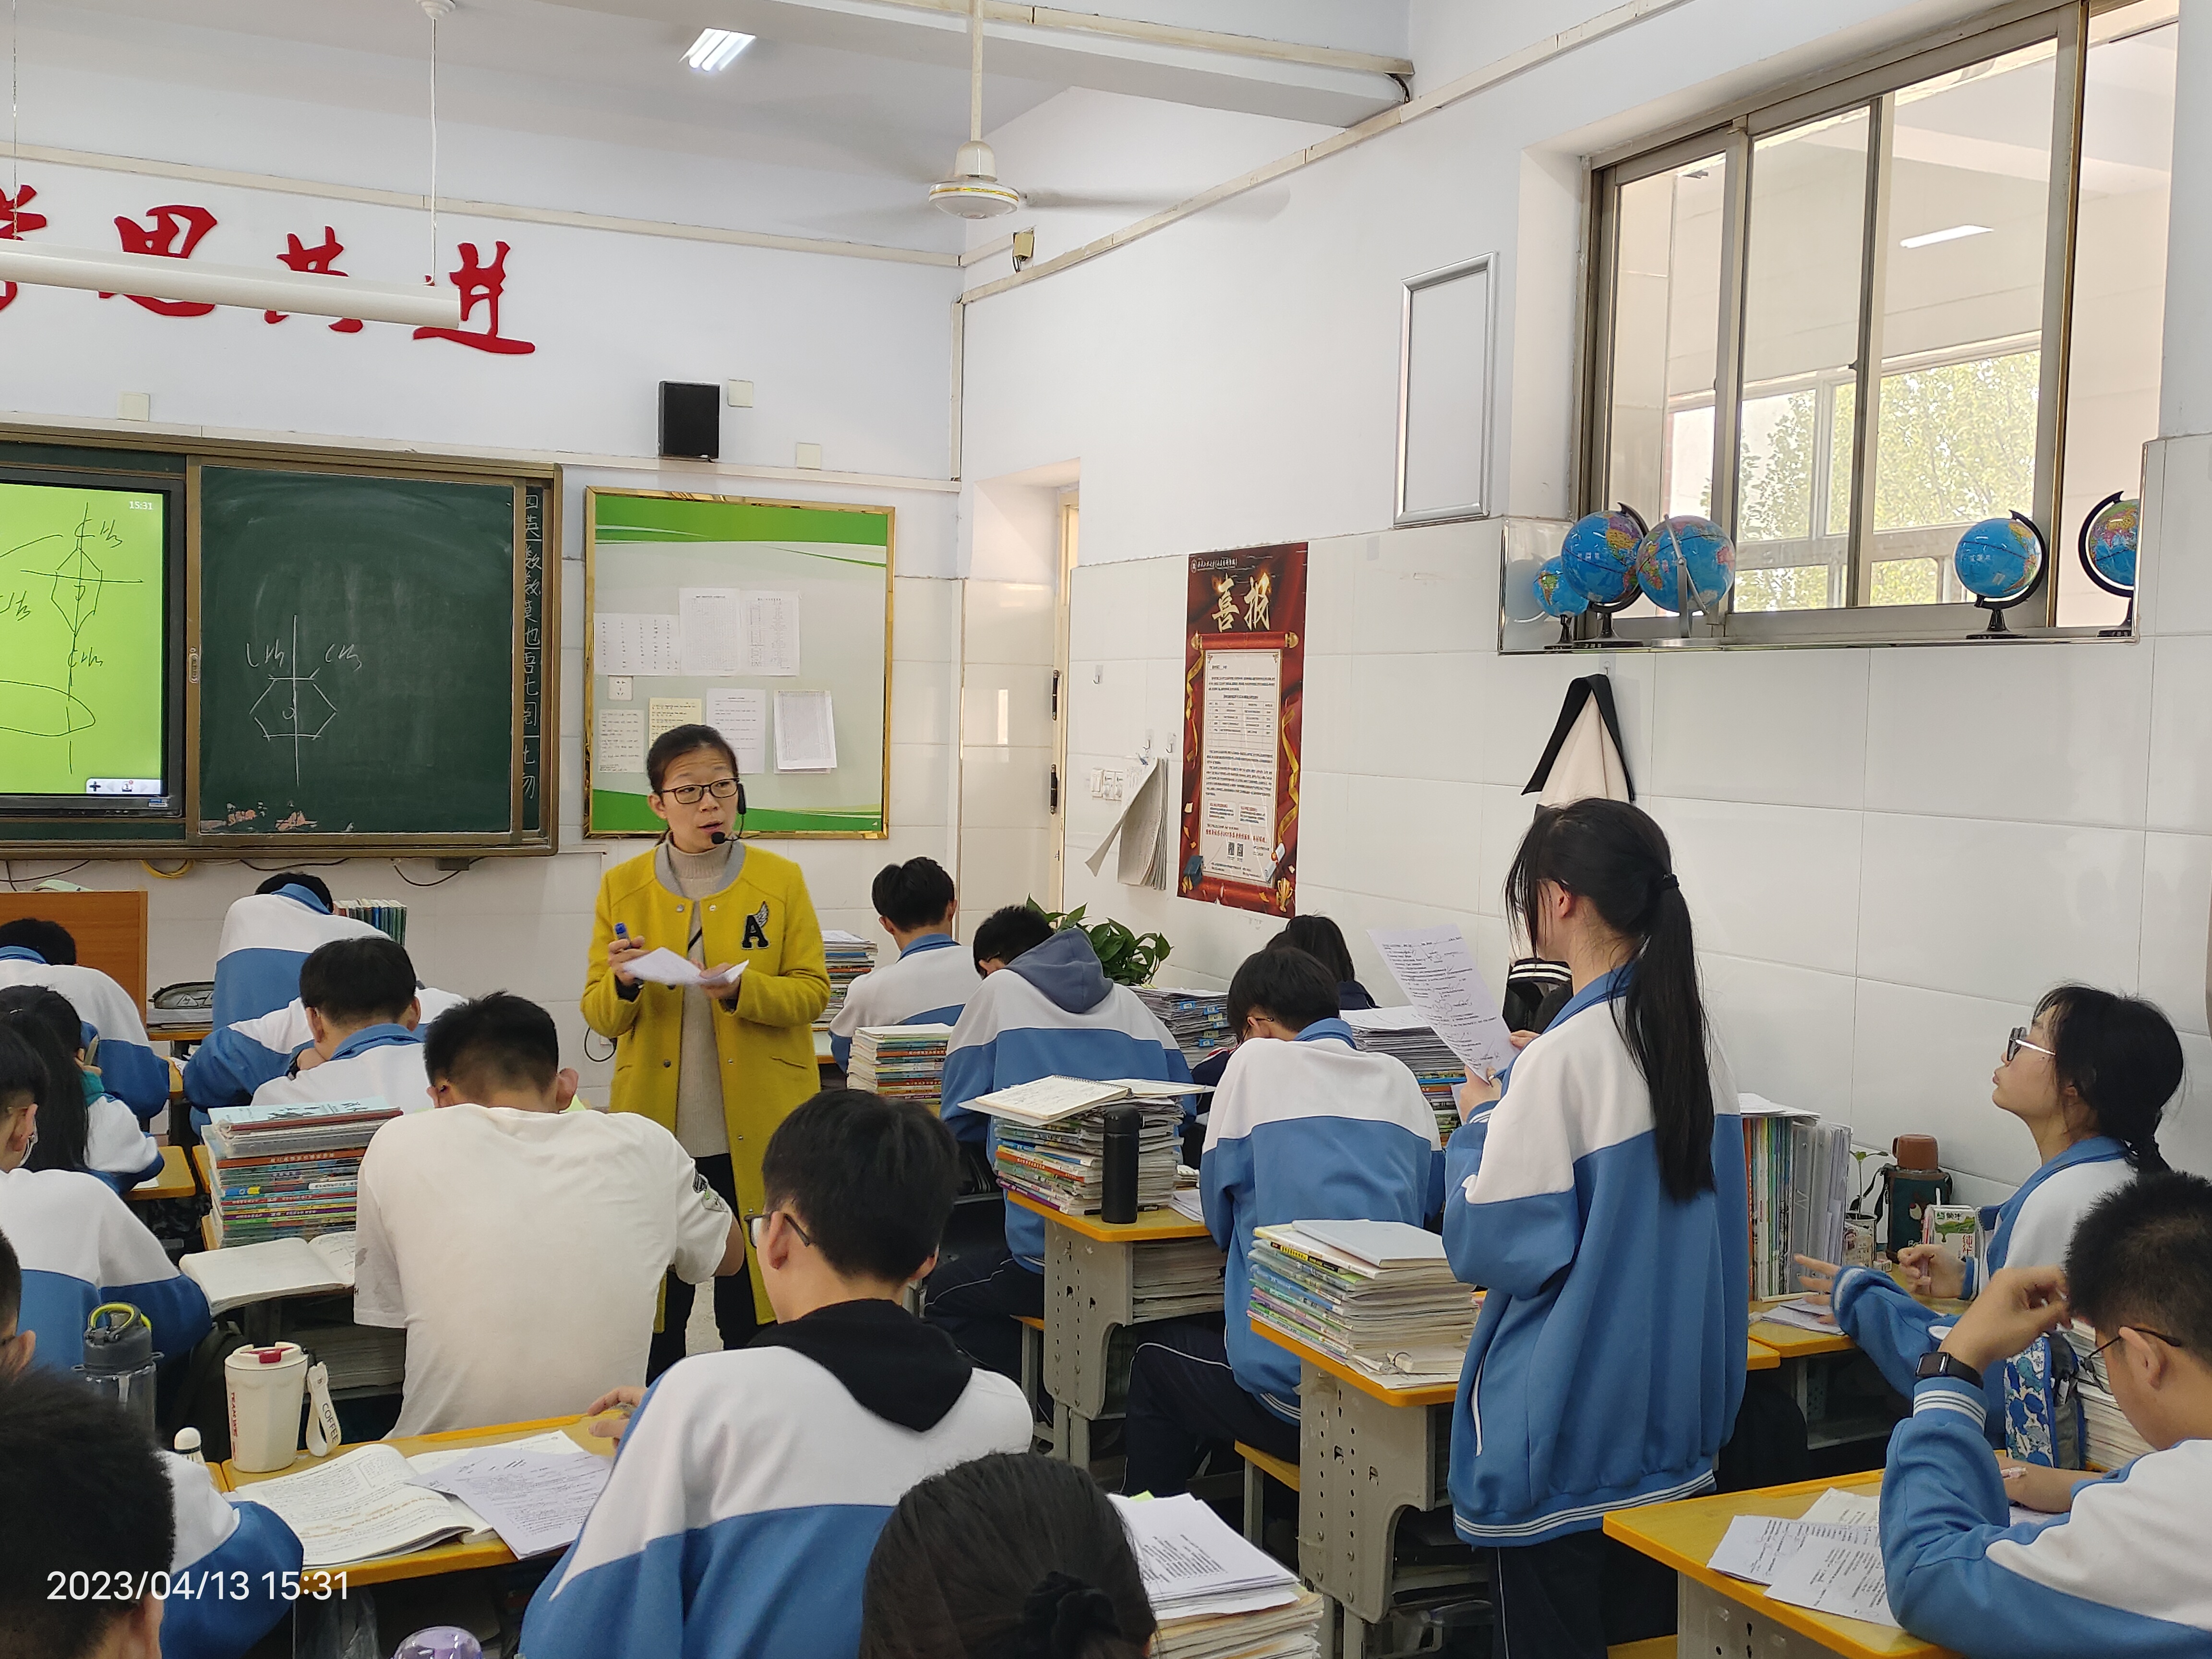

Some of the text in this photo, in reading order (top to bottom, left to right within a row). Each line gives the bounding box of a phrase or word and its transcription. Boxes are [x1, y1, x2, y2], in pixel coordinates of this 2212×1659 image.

[129, 501, 154, 510] 15:31
[1211, 572, 1270, 633] 喜报
[742, 915, 769, 949] A
[322, 1403, 338, 1443] COFFEE
